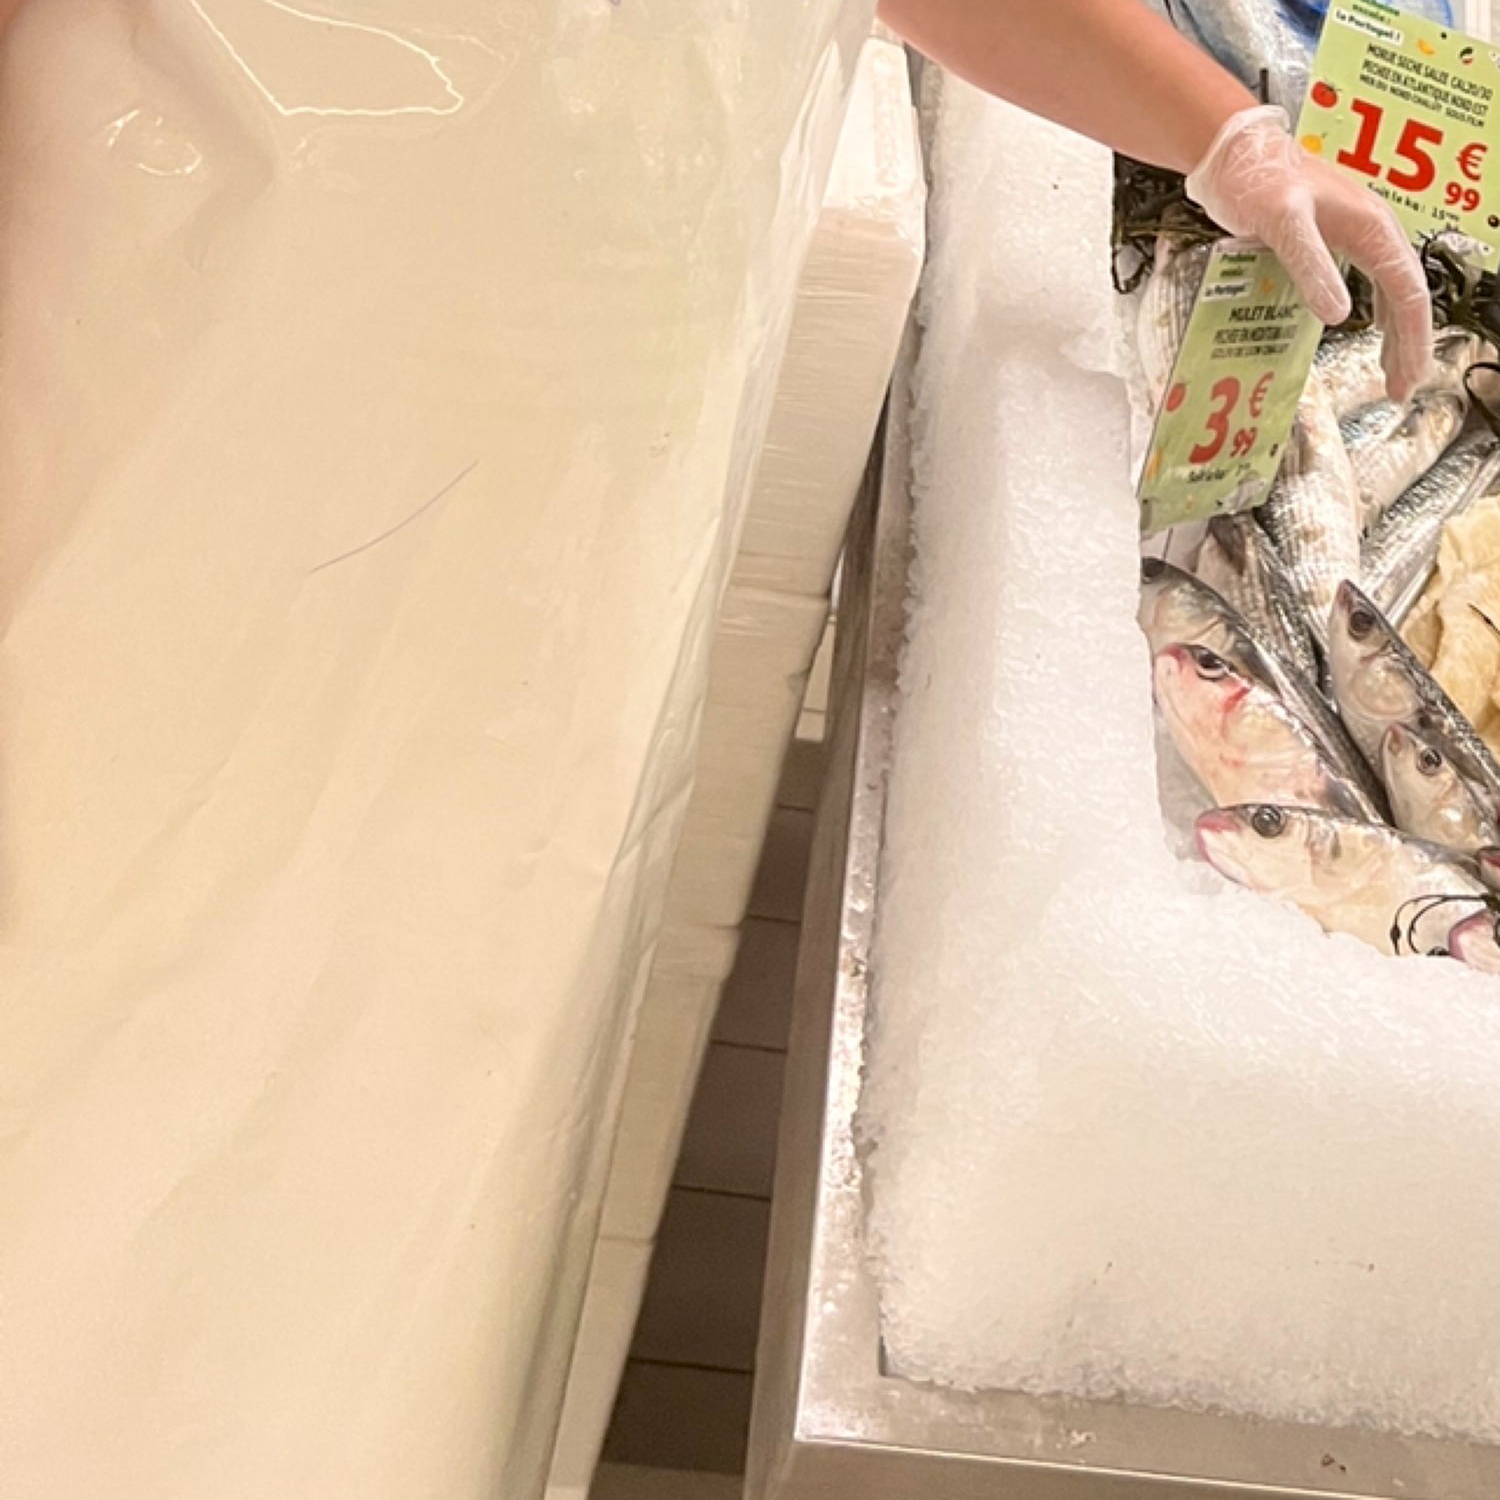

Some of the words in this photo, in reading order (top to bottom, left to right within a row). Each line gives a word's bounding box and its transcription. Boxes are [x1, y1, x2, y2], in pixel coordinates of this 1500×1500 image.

[1336, 97, 1444, 192] 15
[1456, 141, 1489, 182] €
[1443, 181, 1482, 213] 99
[1248, 370, 1275, 419] €
[1189, 375, 1241, 465] 3
[1228, 425, 1258, 459] 99
